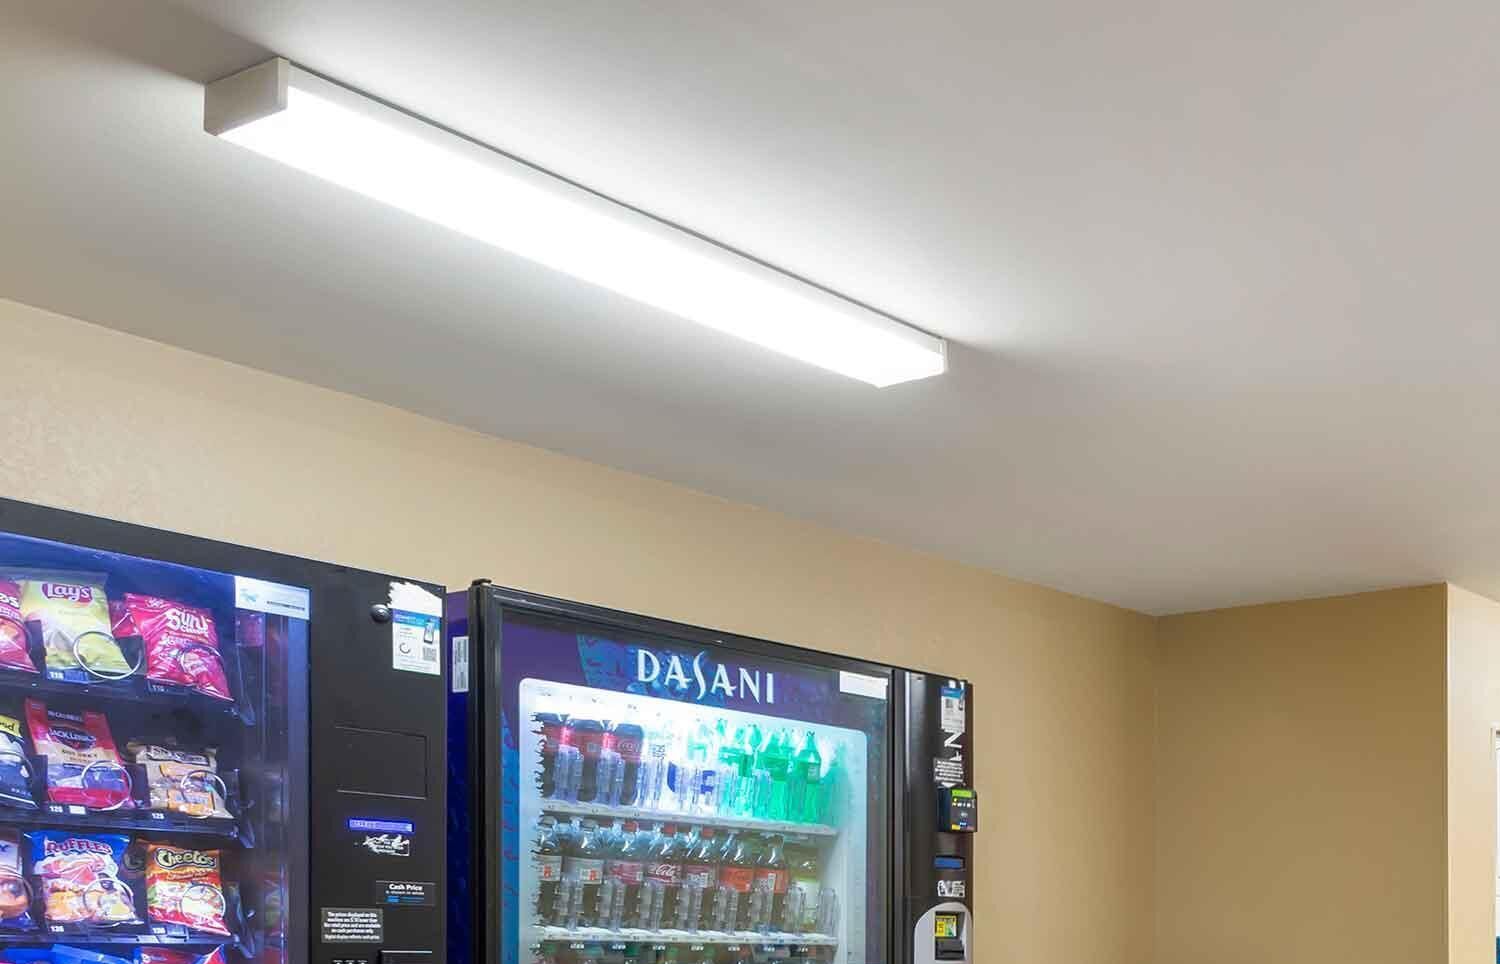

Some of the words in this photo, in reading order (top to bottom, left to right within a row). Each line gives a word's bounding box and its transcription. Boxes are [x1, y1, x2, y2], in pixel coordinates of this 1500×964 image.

[637, 648, 774, 704] DASANI
[47, 839, 112, 856] RUFFLES
[157, 849, 216, 868] Cheetos
[406, 884, 423, 892] Price
